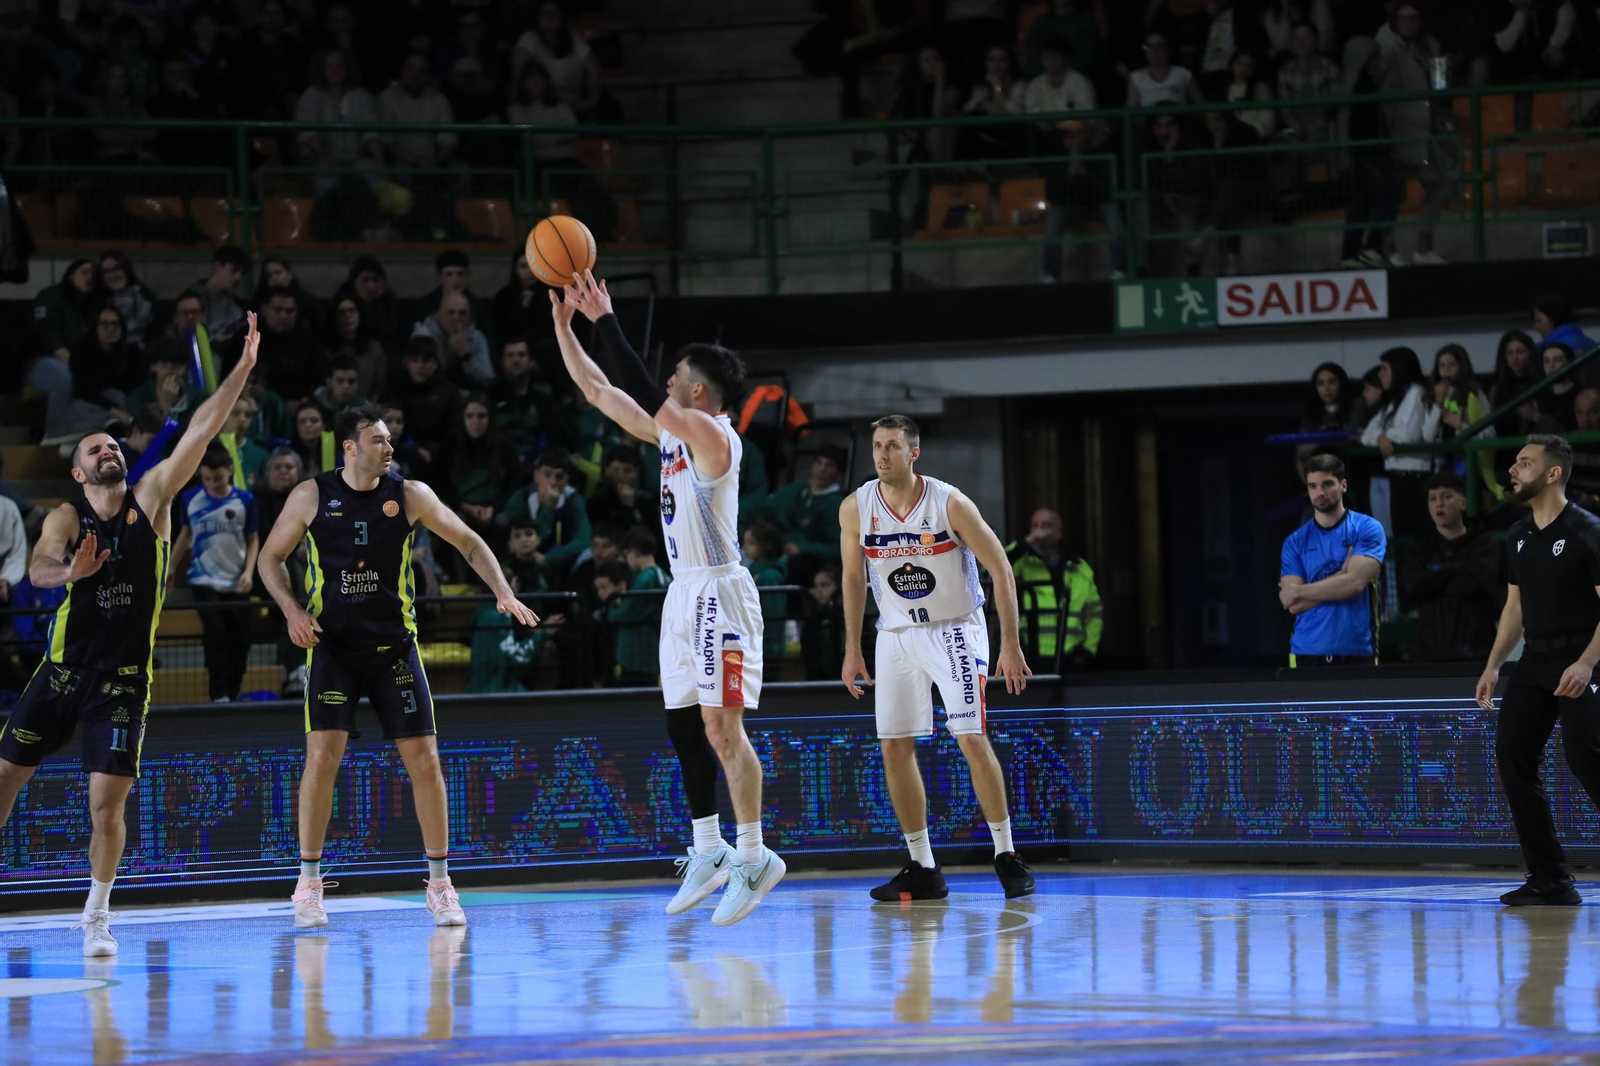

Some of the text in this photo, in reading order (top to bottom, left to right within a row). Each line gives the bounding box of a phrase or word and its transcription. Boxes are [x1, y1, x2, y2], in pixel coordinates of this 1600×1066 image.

[1226, 276, 1379, 318] SAIDA
[354, 521, 368, 545] 3
[877, 546, 934, 559] OBRADOIRO
[340, 570, 379, 582] Estrella
[340, 581, 378, 595] Galicia
[893, 572, 928, 583] Estrella
[896, 581, 928, 592] Galicia
[703, 597, 717, 676] HEY, MADRID
[953, 627, 975, 705] HEY, MADRID
[401, 689, 417, 714] 3
[110, 727, 128, 752] 11
